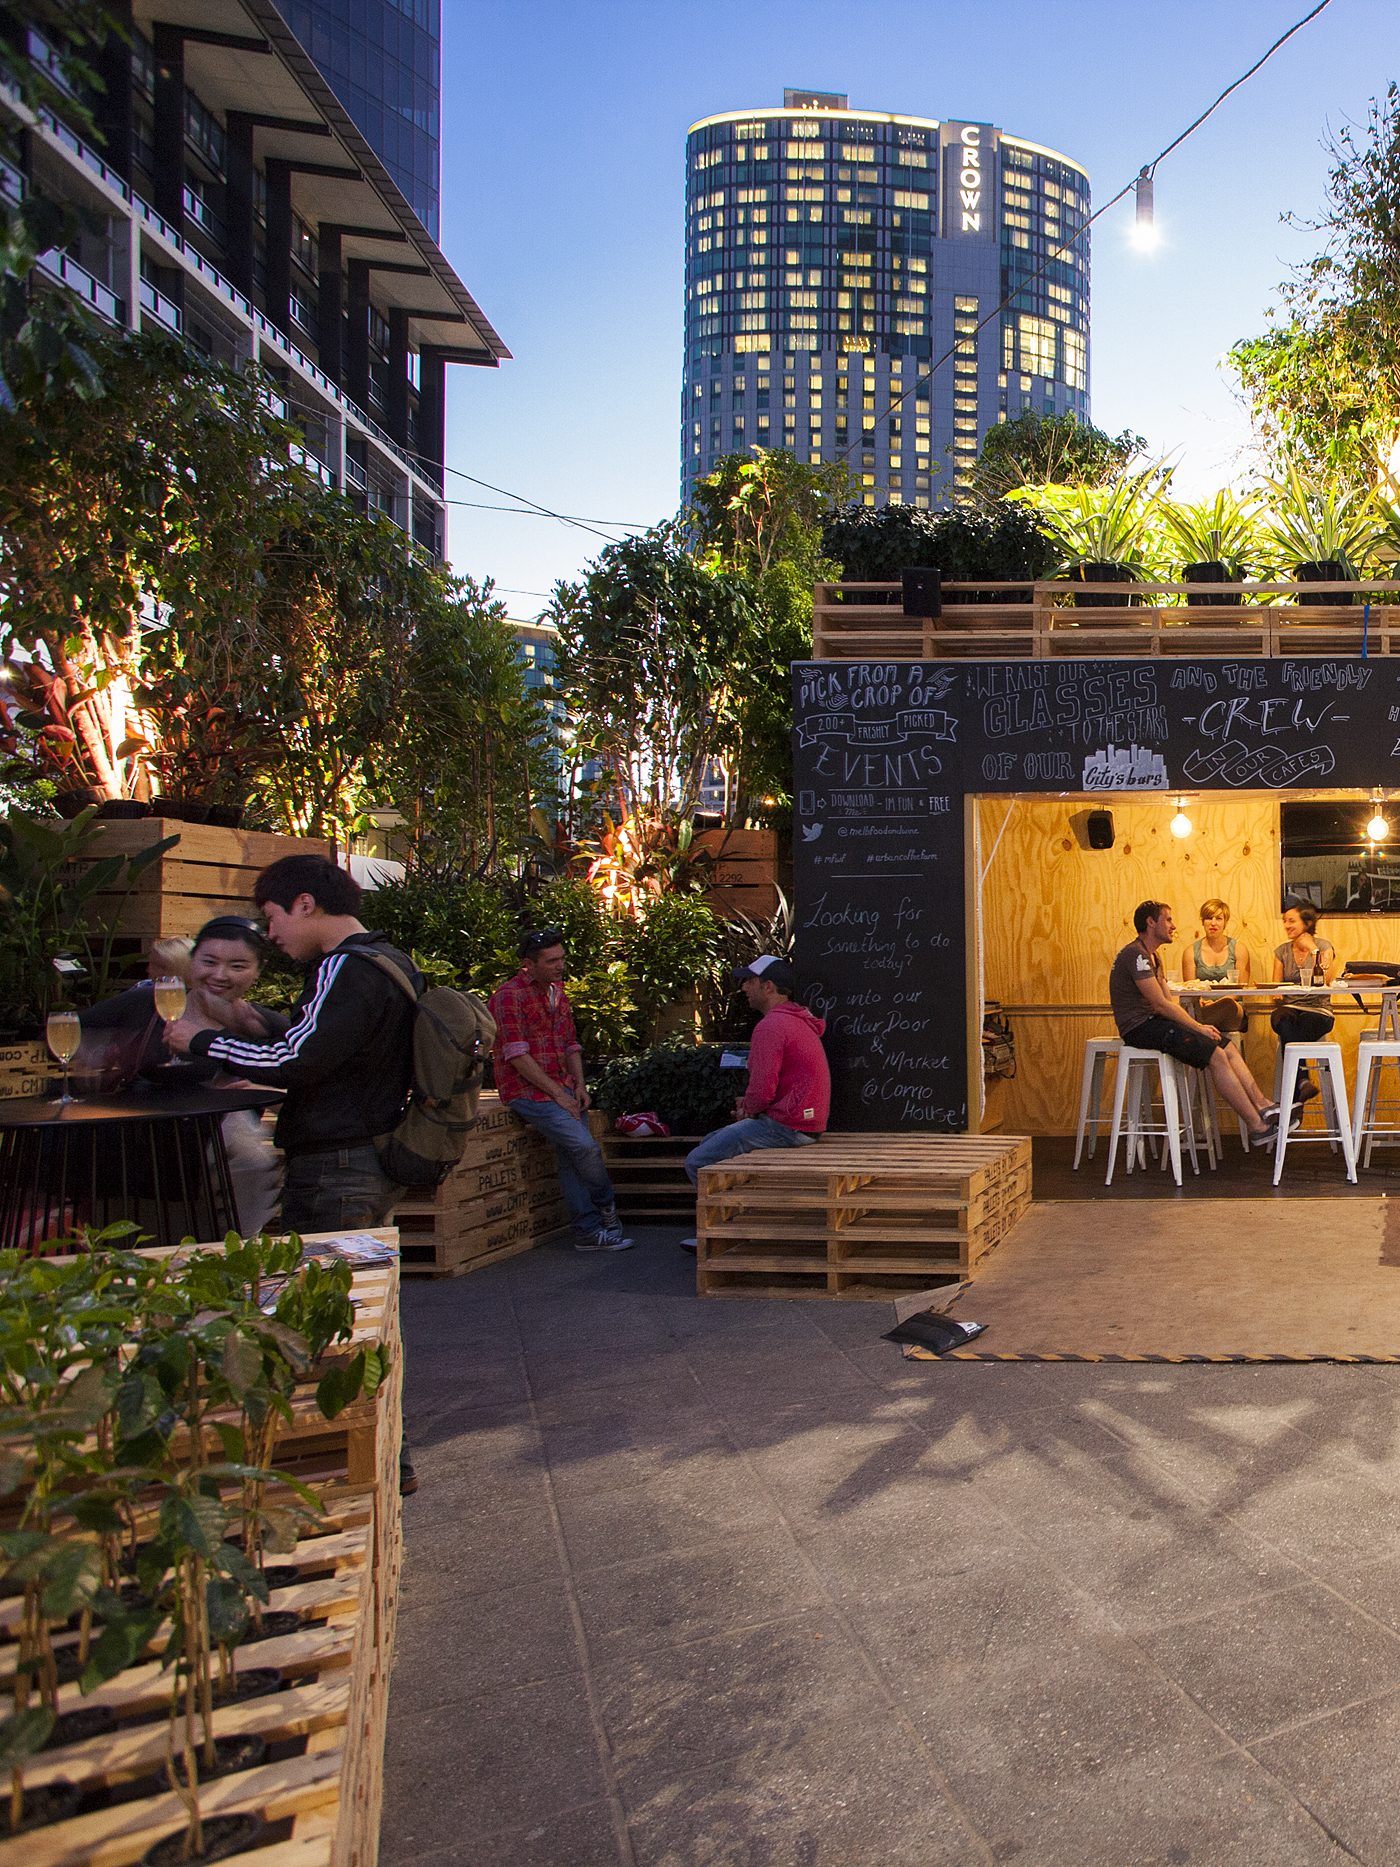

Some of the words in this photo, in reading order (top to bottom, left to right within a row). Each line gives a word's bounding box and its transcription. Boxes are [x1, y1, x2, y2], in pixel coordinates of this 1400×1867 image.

[960, 126, 981, 232] CROWN
[800, 672, 842, 709] PICK
[848, 665, 898, 690] FROM
[907, 665, 924, 686] A
[976, 667, 1003, 699] WE
[1005, 664, 1051, 694] RAISE
[1059, 663, 1089, 682] OUR
[1170, 667, 1218, 693] AND
[1222, 663, 1268, 691] THE
[1282, 662, 1372, 692] FRIENDLY
[850, 684, 903, 709] CROP
[908, 686, 936, 706] OF
[983, 666, 1157, 739] GLASSES
[817, 716, 845, 731] 200+
[858, 725, 889, 739] FRESHLY
[904, 714, 935, 728] PICKED
[1065, 720, 1093, 745] TO
[1098, 712, 1125, 743] THE
[1127, 705, 1169, 742] STARS
[811, 742, 942, 787] EVENTS
[981, 752, 1018, 780] OF
[1023, 752, 1075, 780] OUR
[1085, 767, 1125, 789] City's
[1127, 767, 1162, 786] bars
[1206, 752, 1226, 770] IN
[1235, 751, 1270, 777] OUR
[1272, 750, 1321, 782] CAFES
[831, 793, 874, 807] DOWNLOAD
[898, 797, 914, 811] FUN
[929, 796, 951, 811] FREE
[803, 892, 880, 935] Looking
[894, 897, 924, 929] for
[906, 932, 919, 949] to
[930, 933, 950, 948] do
[863, 955, 913, 978] today?
[803, 983, 837, 1020] Pop
[846, 989, 882, 1007] into
[894, 989, 923, 1004] our
[833, 1015, 885, 1035] Cellar
[882, 1010, 930, 1040] Door
[870, 1035, 883, 1055] &
[883, 1051, 950, 1071] Market
[861, 1078, 878, 1104] @
[476, 1110, 514, 1133] PALLETS
[901, 1103, 966, 1126] House!
[479, 1168, 516, 1191] PALLETS
